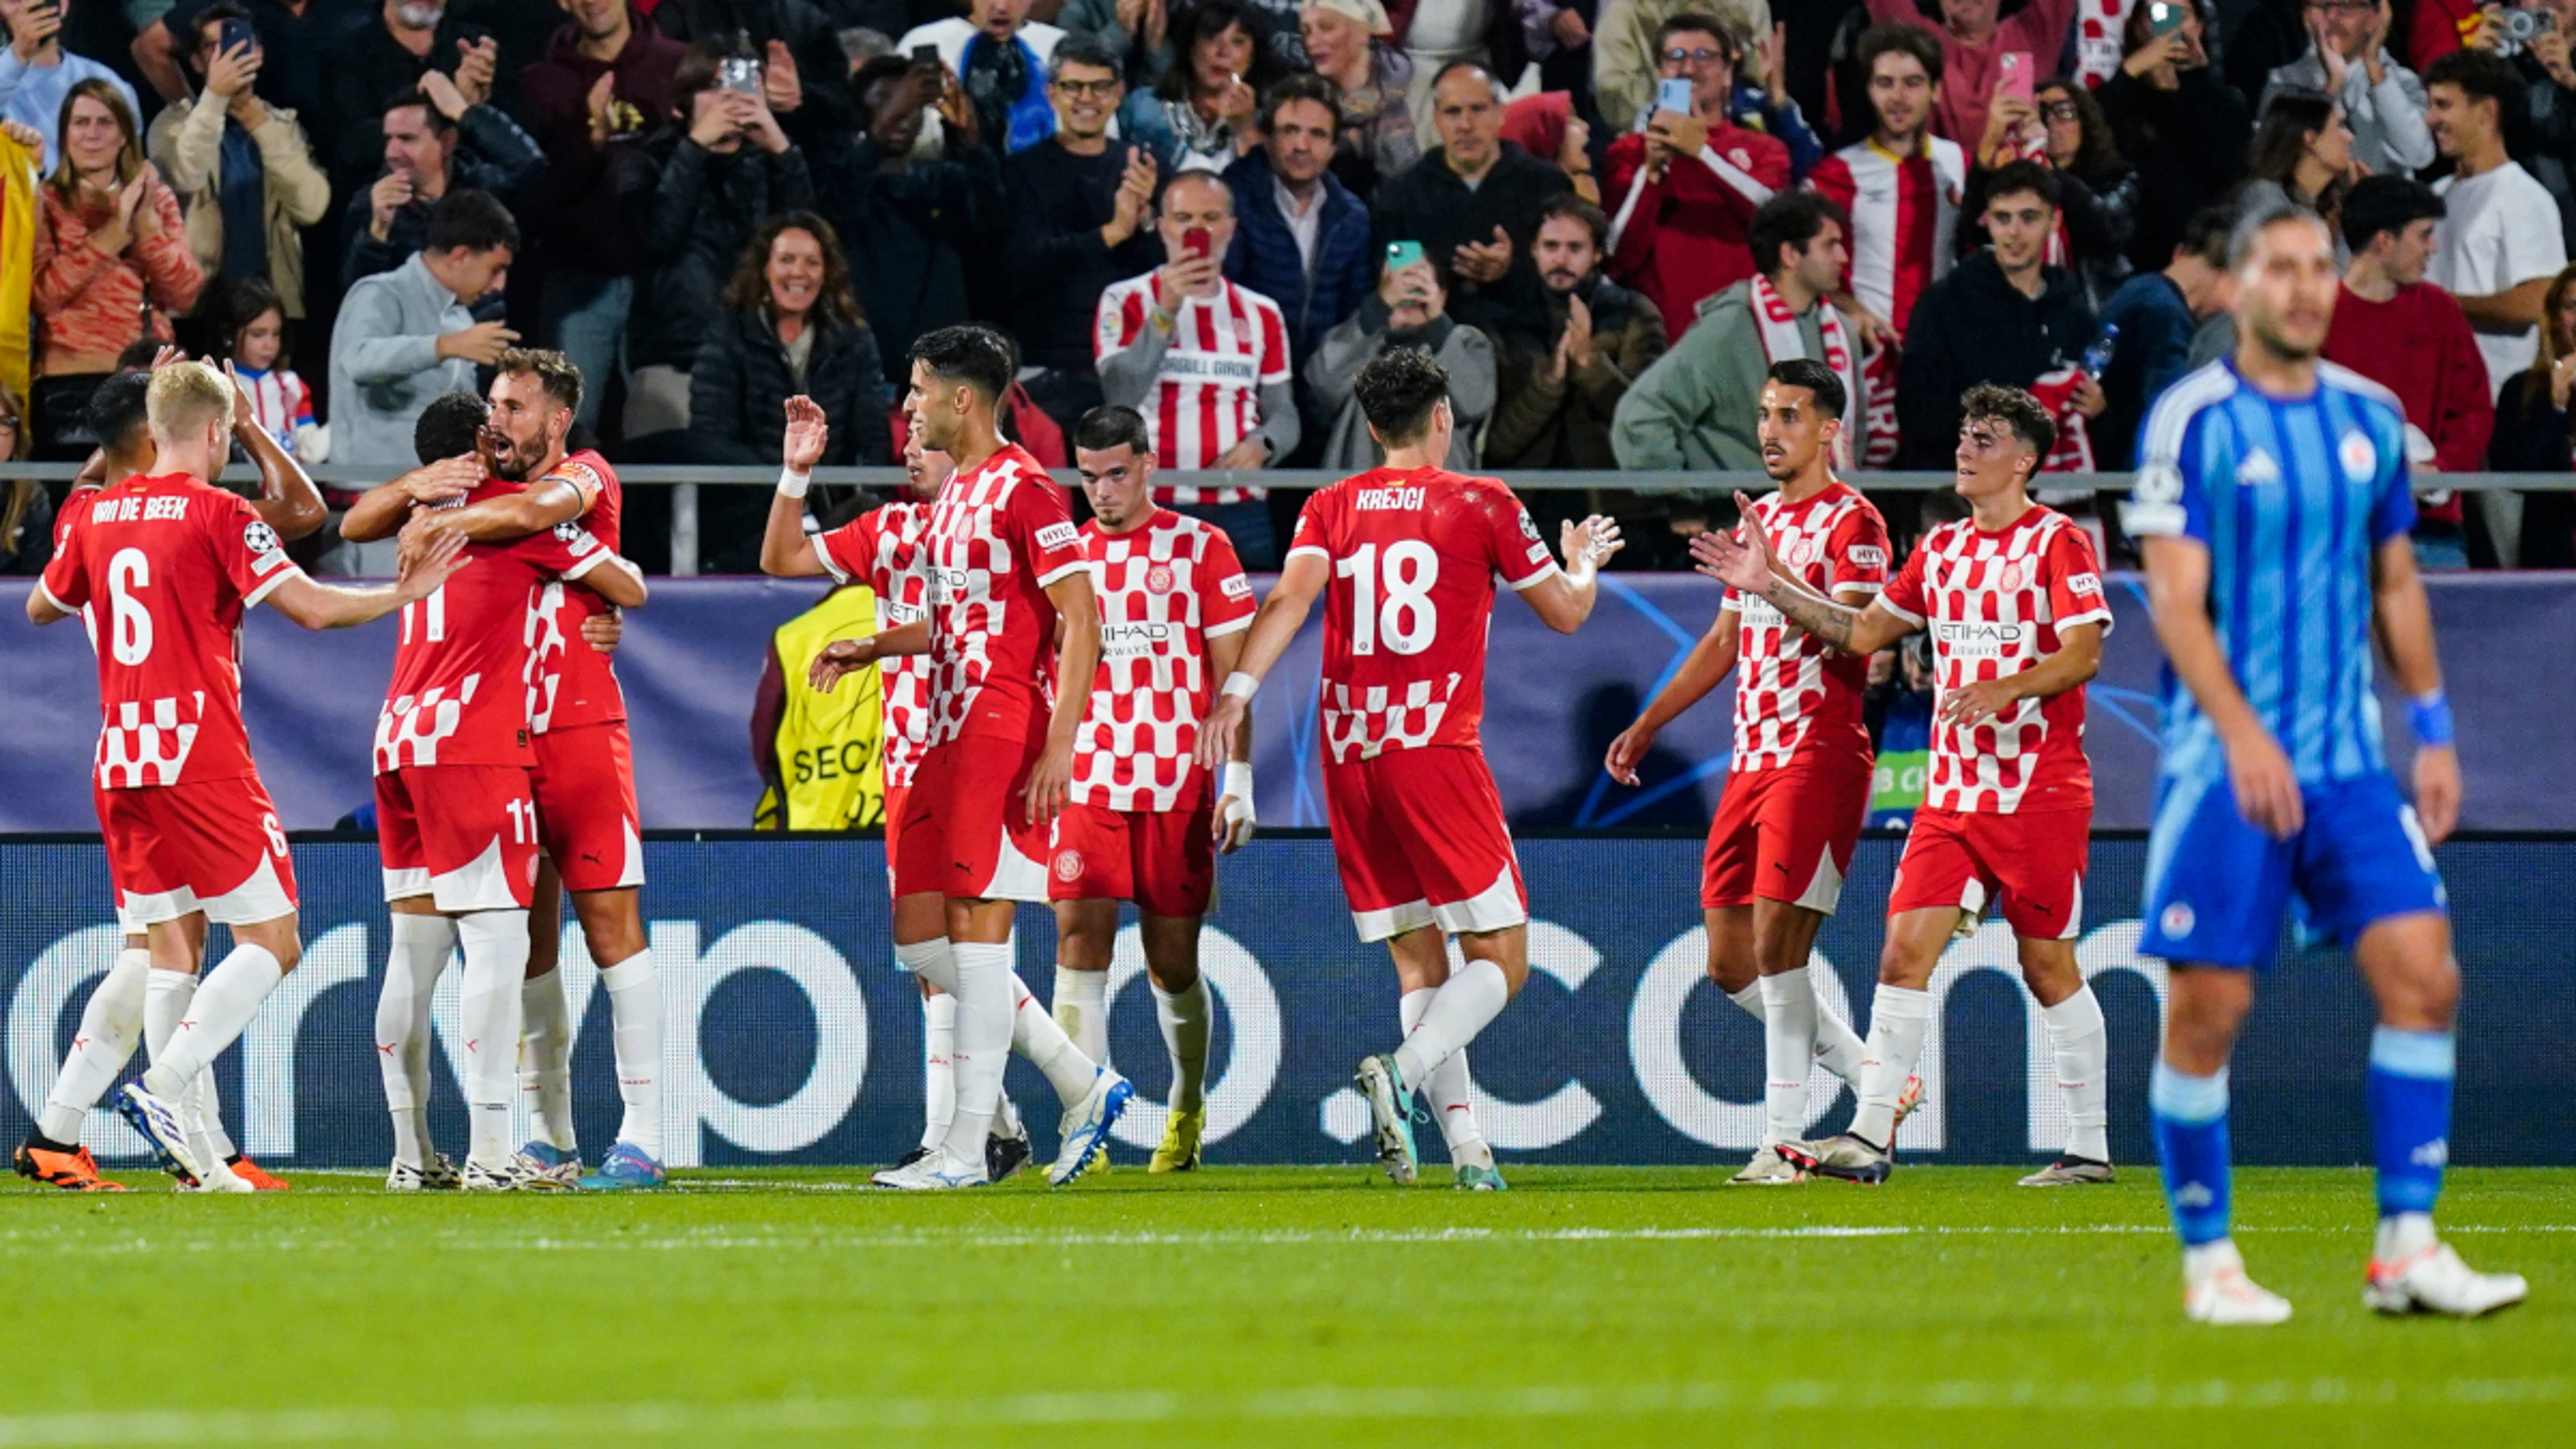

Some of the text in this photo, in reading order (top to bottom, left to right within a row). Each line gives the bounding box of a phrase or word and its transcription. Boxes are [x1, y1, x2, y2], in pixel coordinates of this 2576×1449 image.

[93, 496, 189, 524] VAN DE BEEK
[1356, 487, 1426, 511] KREJCI
[109, 547, 154, 666] 6
[1336, 539, 1439, 655] 18
[1940, 624, 2021, 640] ETIHAD
[263, 812, 288, 858] 6
[506, 798, 537, 845] 11
[3, 920, 2171, 1167] crypo.com
